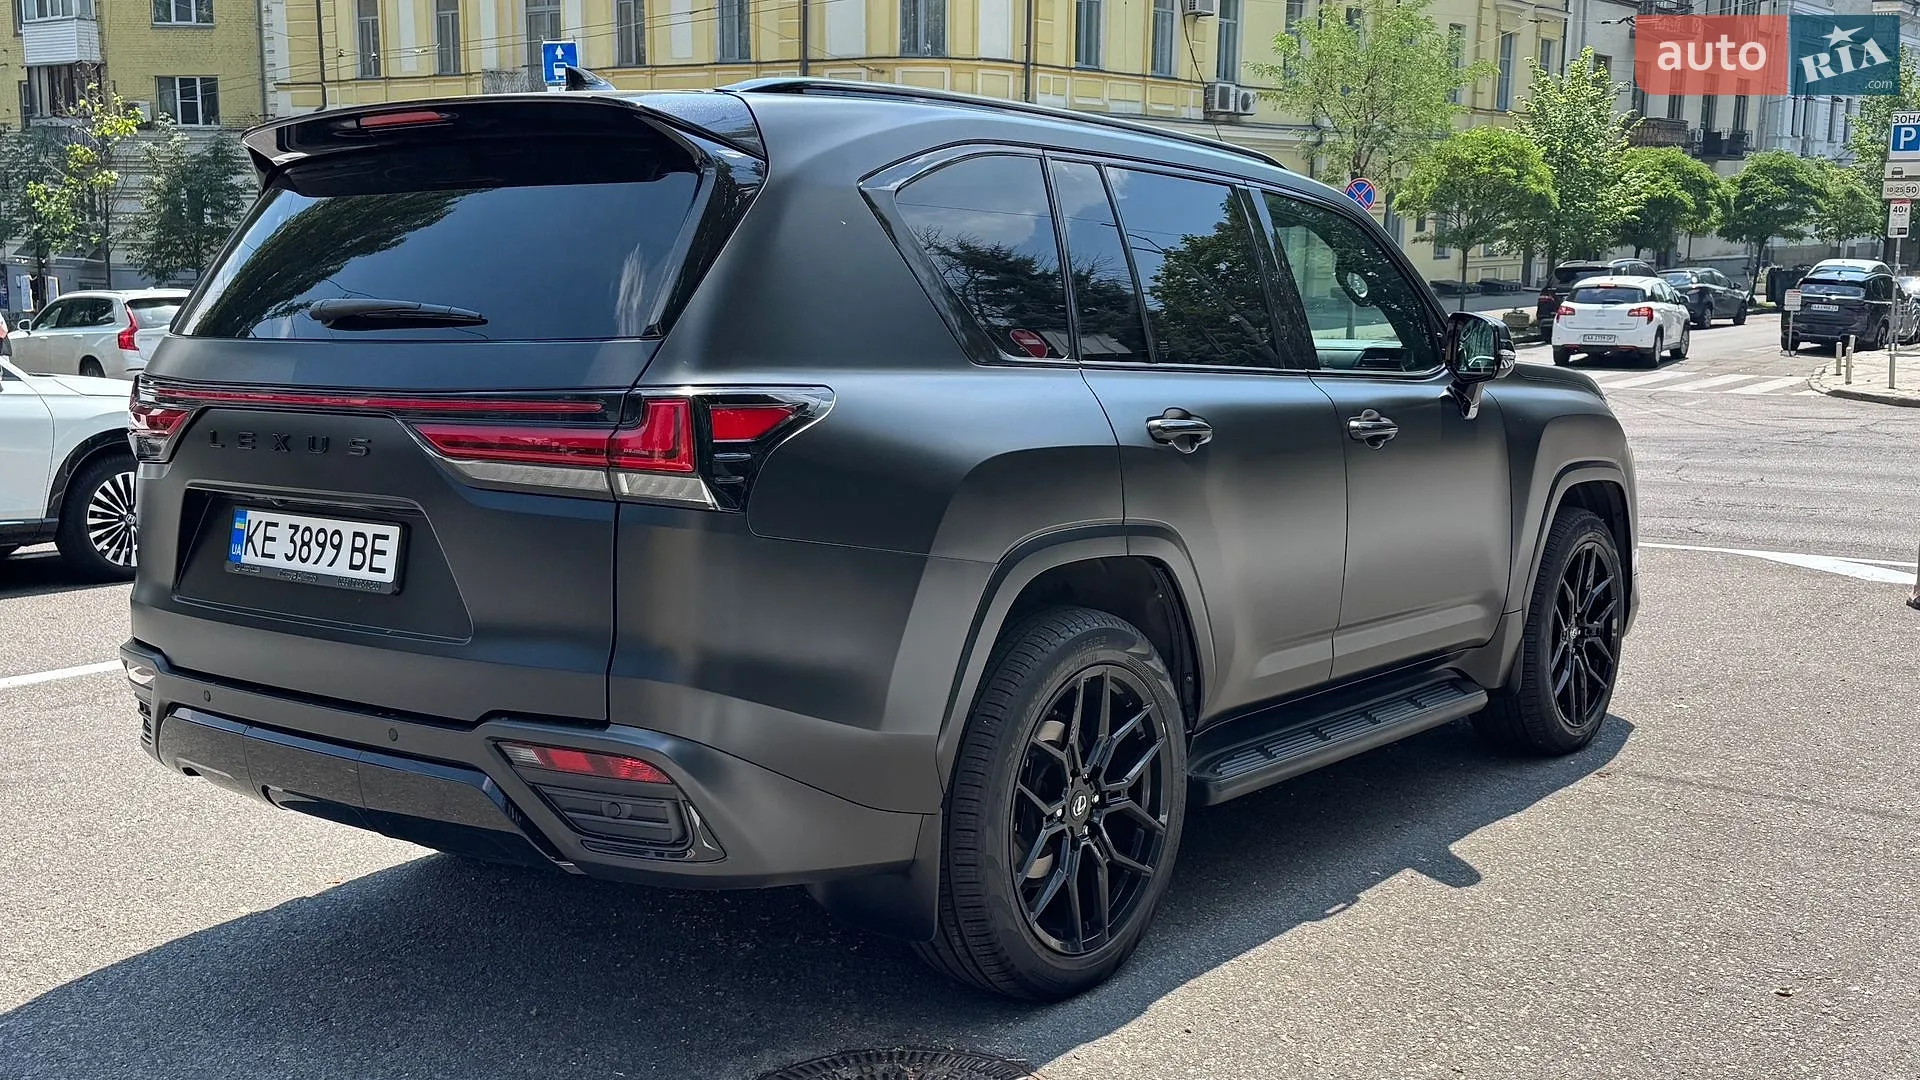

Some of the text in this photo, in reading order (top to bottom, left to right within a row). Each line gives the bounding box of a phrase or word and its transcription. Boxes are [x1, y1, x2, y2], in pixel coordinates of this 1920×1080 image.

[1899, 126, 1917, 150] P
[209, 430, 372, 457] LEXUS
[231, 543, 242, 556] UA
[243, 519, 390, 574] KE 3899 BE
